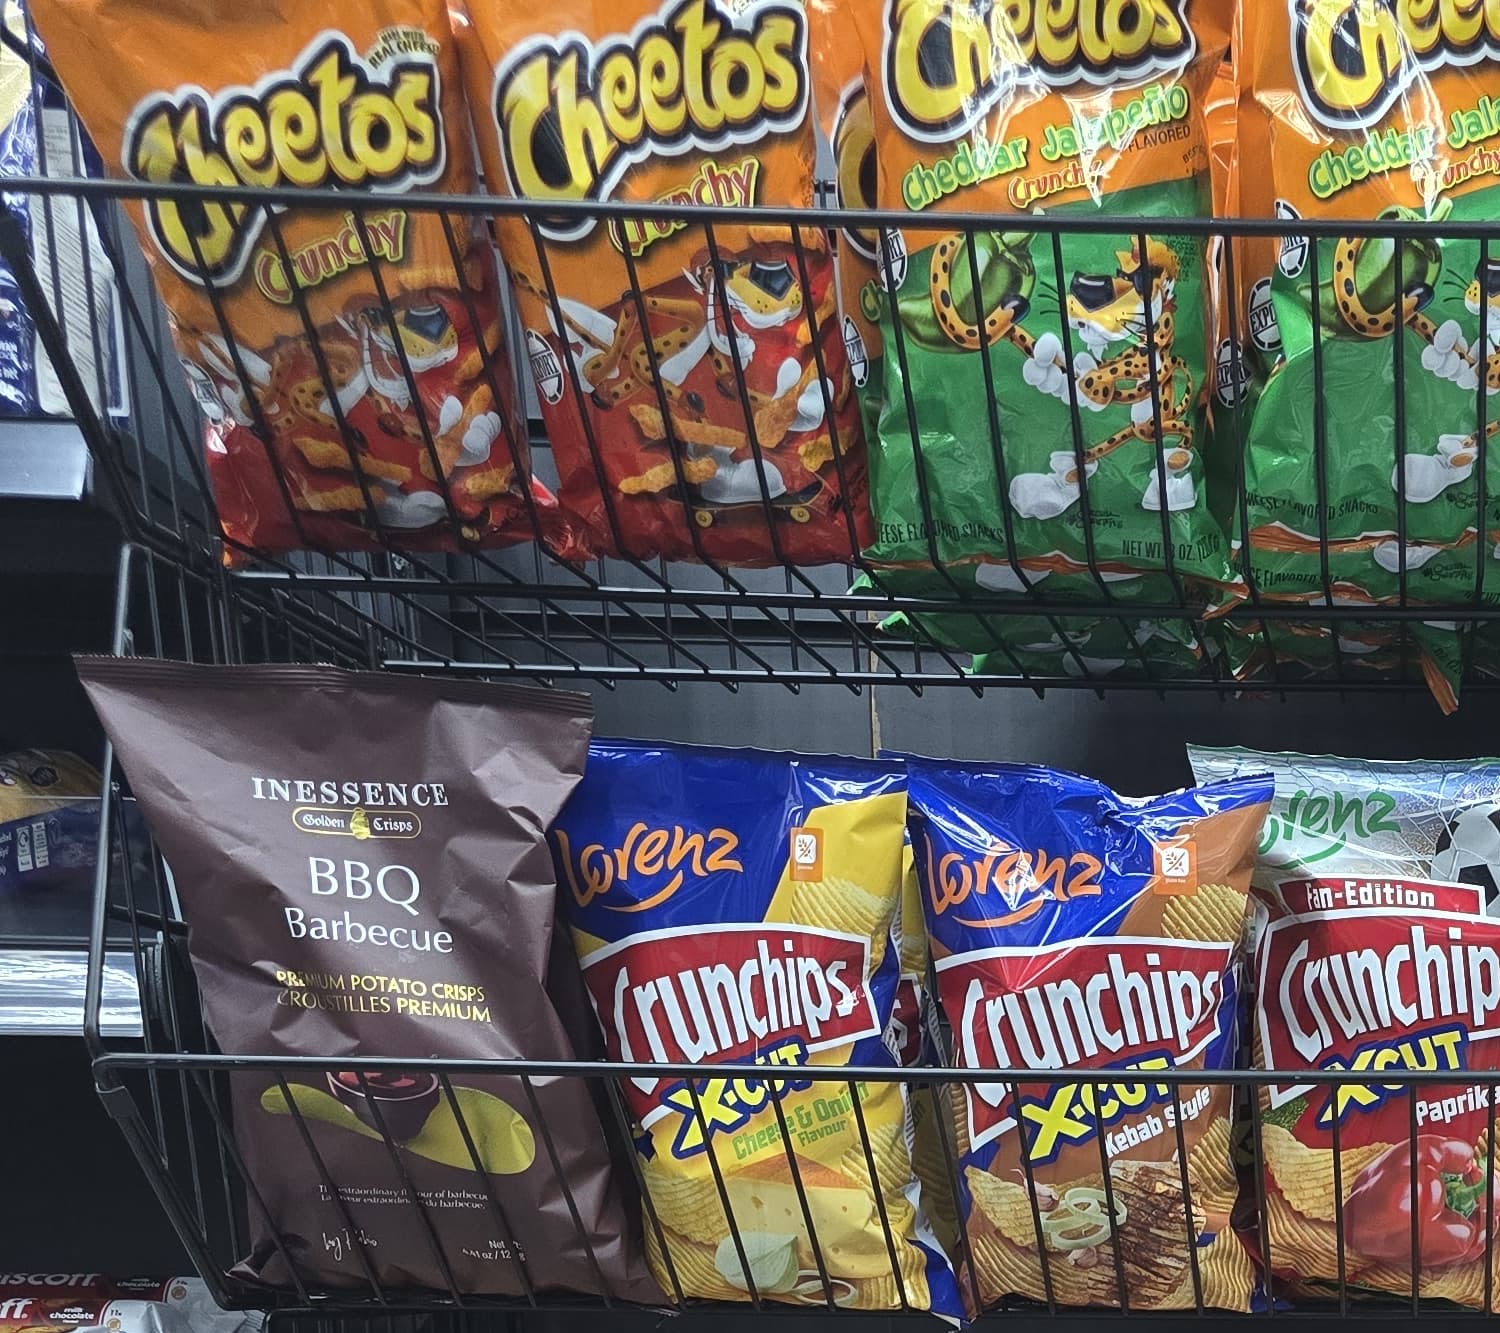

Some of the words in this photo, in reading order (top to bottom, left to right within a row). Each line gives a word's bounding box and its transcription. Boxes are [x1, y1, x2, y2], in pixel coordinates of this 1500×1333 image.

[1129, 126, 1191, 153] FLAVORED
[902, 138, 1029, 210] Cheddar
[258, 212, 406, 304] Crunchy
[251, 778, 448, 806] INESSENCE
[303, 814, 344, 828] Golden
[373, 817, 413, 832] Crisps
[309, 857, 420, 915] BBQ
[555, 823, 743, 912] Lorenz
[284, 907, 453, 953] Barbecue
[351, 975, 426, 994] POTATO
[432, 983, 484, 1002] CRISPS
[397, 998, 491, 1022] PREMIUM
[616, 937, 863, 1094] Crunchips
[962, 949, 1222, 1108] Crunchips
[798, 1118, 846, 1148] Flavour
[1105, 1113, 1163, 1160] Kebab
